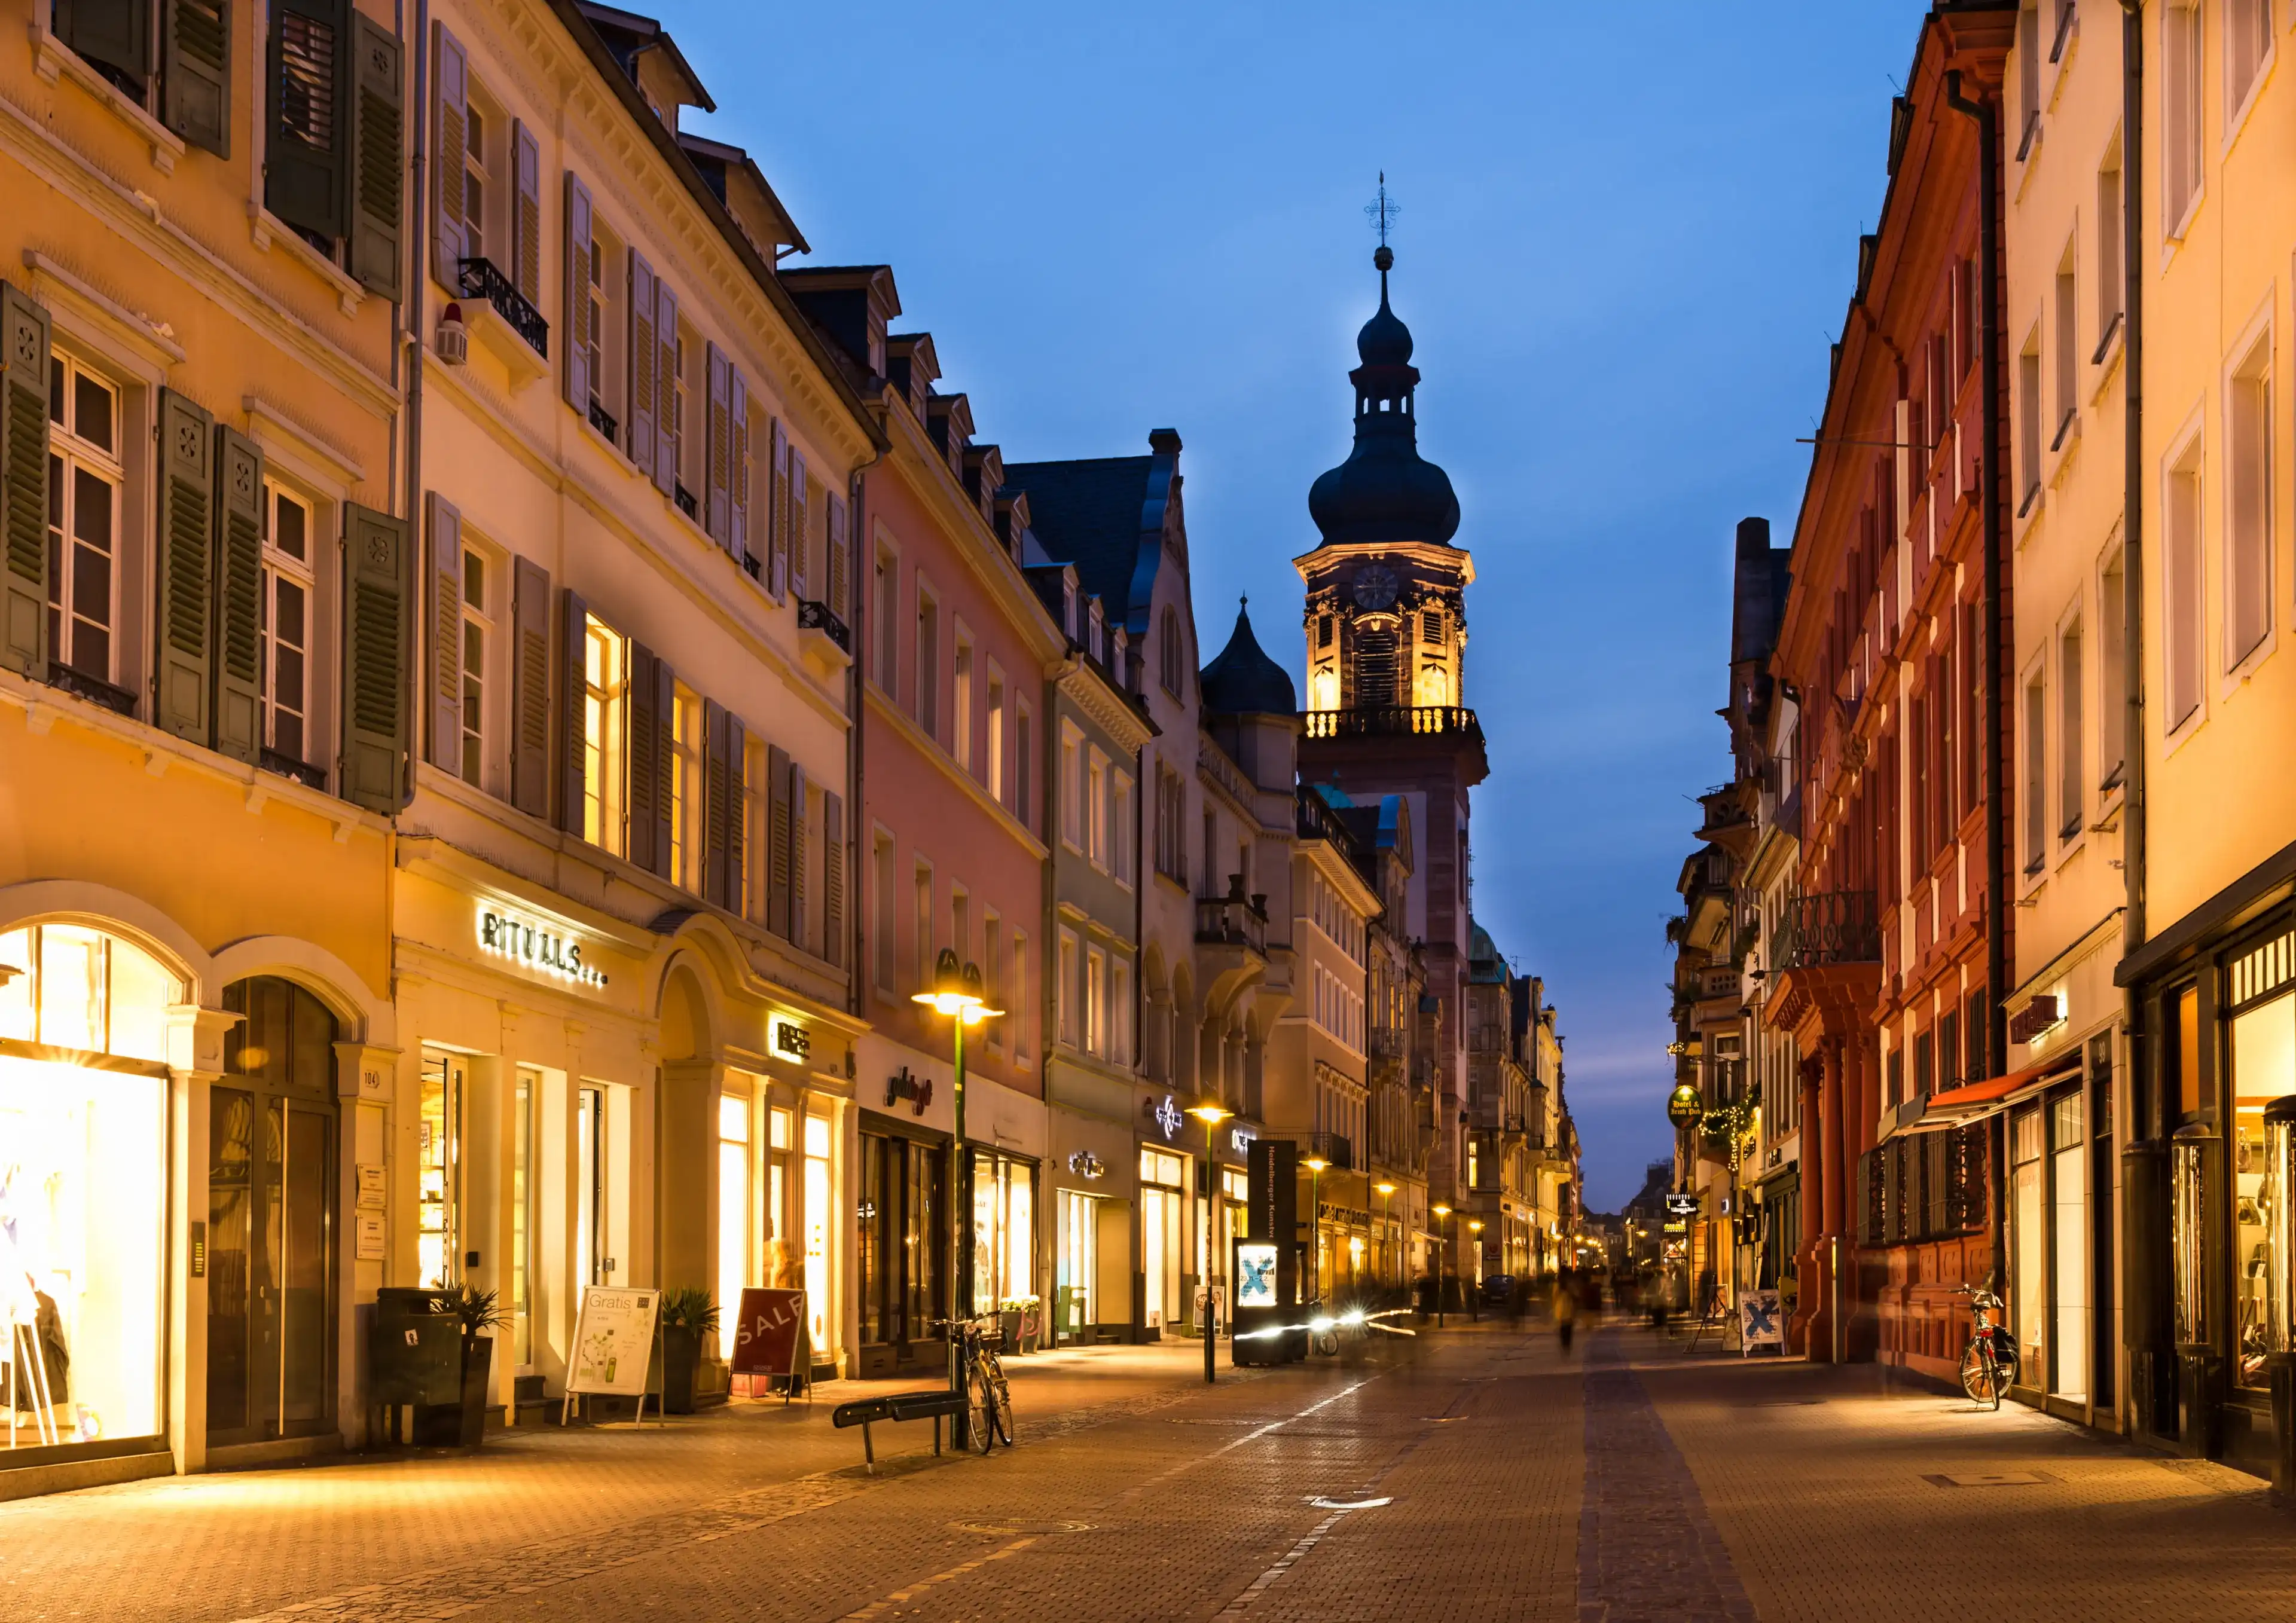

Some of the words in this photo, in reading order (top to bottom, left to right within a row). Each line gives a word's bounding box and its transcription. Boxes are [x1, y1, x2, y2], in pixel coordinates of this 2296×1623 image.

[364, 1072, 375, 1086] 104
[1688, 1108, 1701, 1116] Pub
[590, 1294, 631, 1309] Gratis
